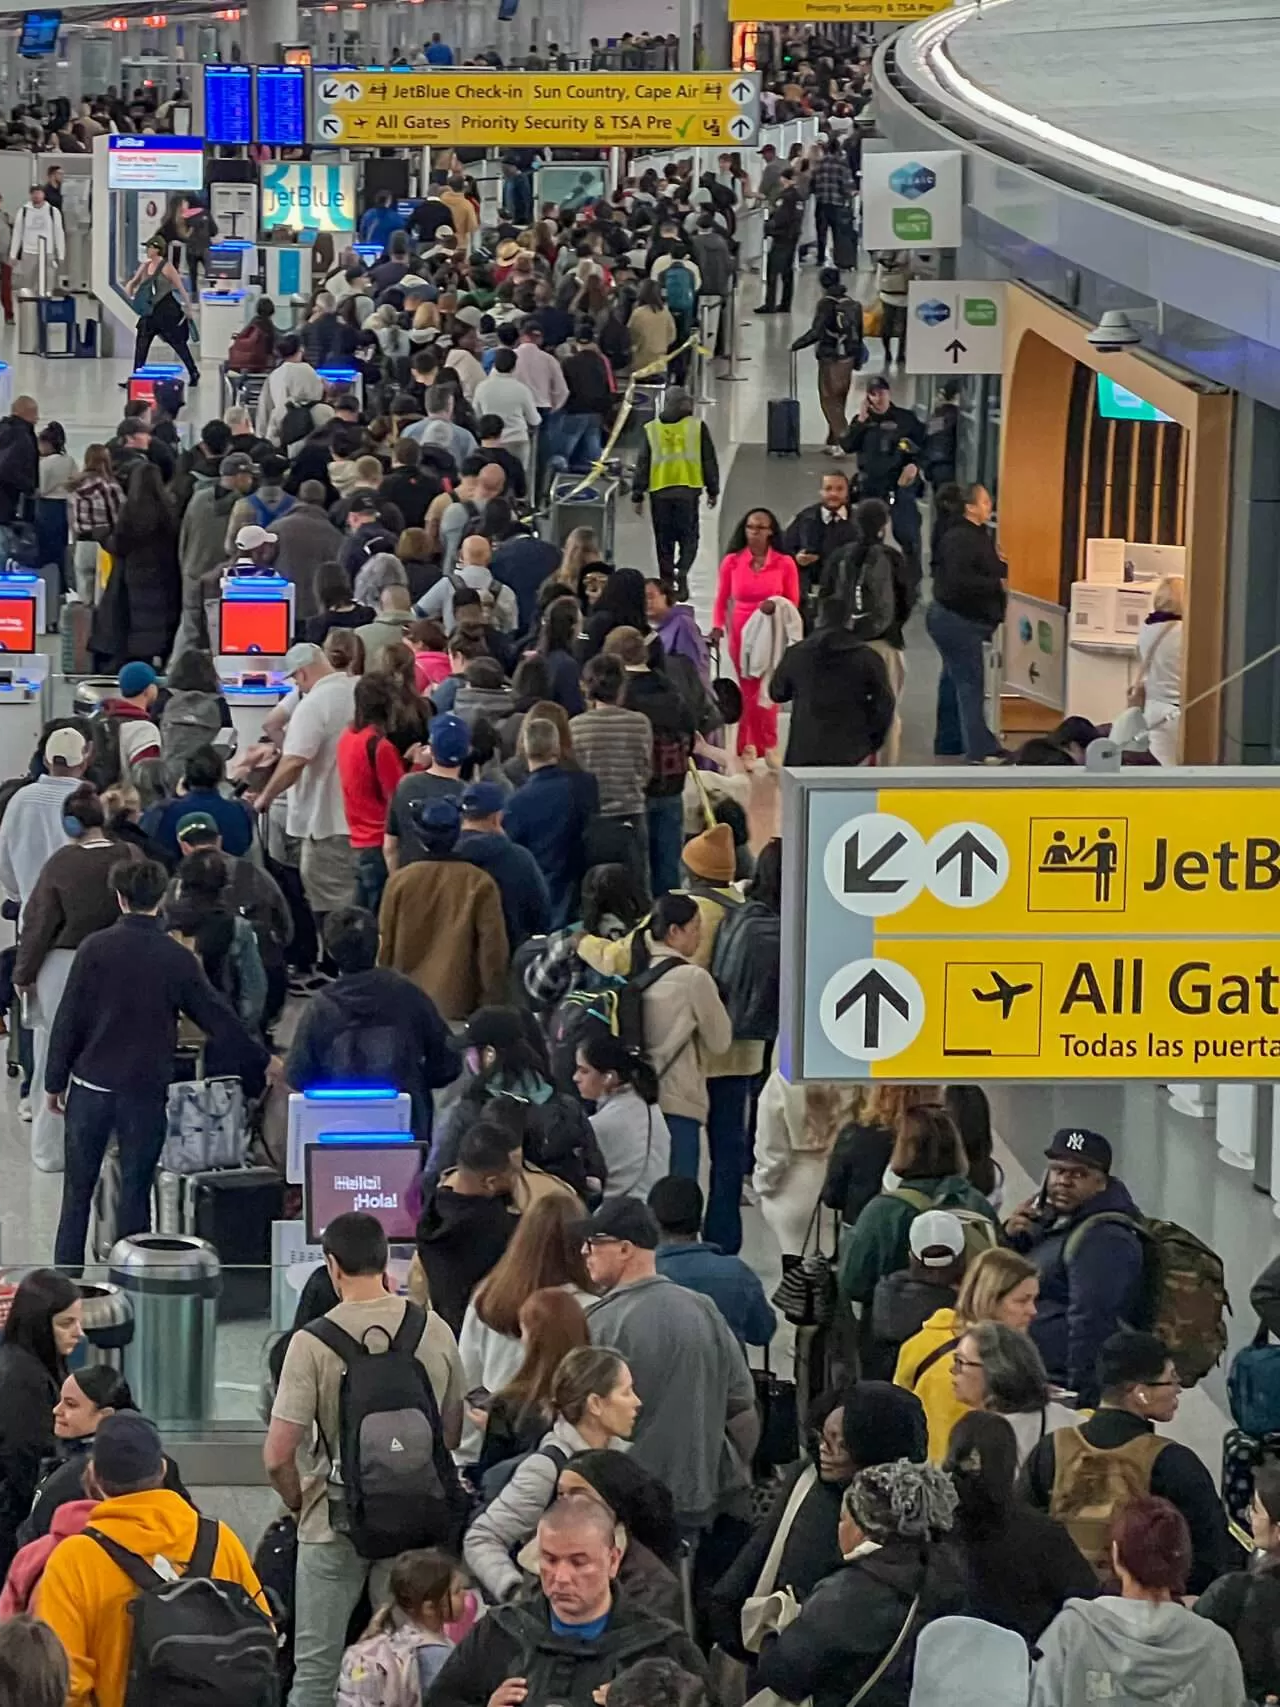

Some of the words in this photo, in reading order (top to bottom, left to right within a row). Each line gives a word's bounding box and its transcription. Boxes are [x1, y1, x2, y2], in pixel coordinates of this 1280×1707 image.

[392, 85, 450, 99] JetBlue
[455, 84, 523, 98] Check-in
[533, 85, 561, 98] Sun
[566, 85, 630, 102] Country,
[635, 85, 672, 101] Cape
[676, 84, 699, 98] Air
[376, 114, 398, 129] All
[404, 115, 451, 129] Gates
[461, 115, 519, 133] Priority
[524, 115, 588, 132] Security
[594, 116, 605, 129] &
[610, 115, 642, 129] TSA
[647, 115, 672, 129] Pre
[268, 185, 345, 211] jetBlue
[1144, 838, 1280, 891] JetB
[1059, 958, 1143, 1014] All
[1169, 962, 1280, 1016] Gat
[1060, 1032, 1137, 1057] Todas
[1148, 1032, 1184, 1057] las
[1194, 1036, 1280, 1063] puerta
[333, 1175, 381, 1191] Hello!
[353, 1193, 398, 1212] ¡Hola!
